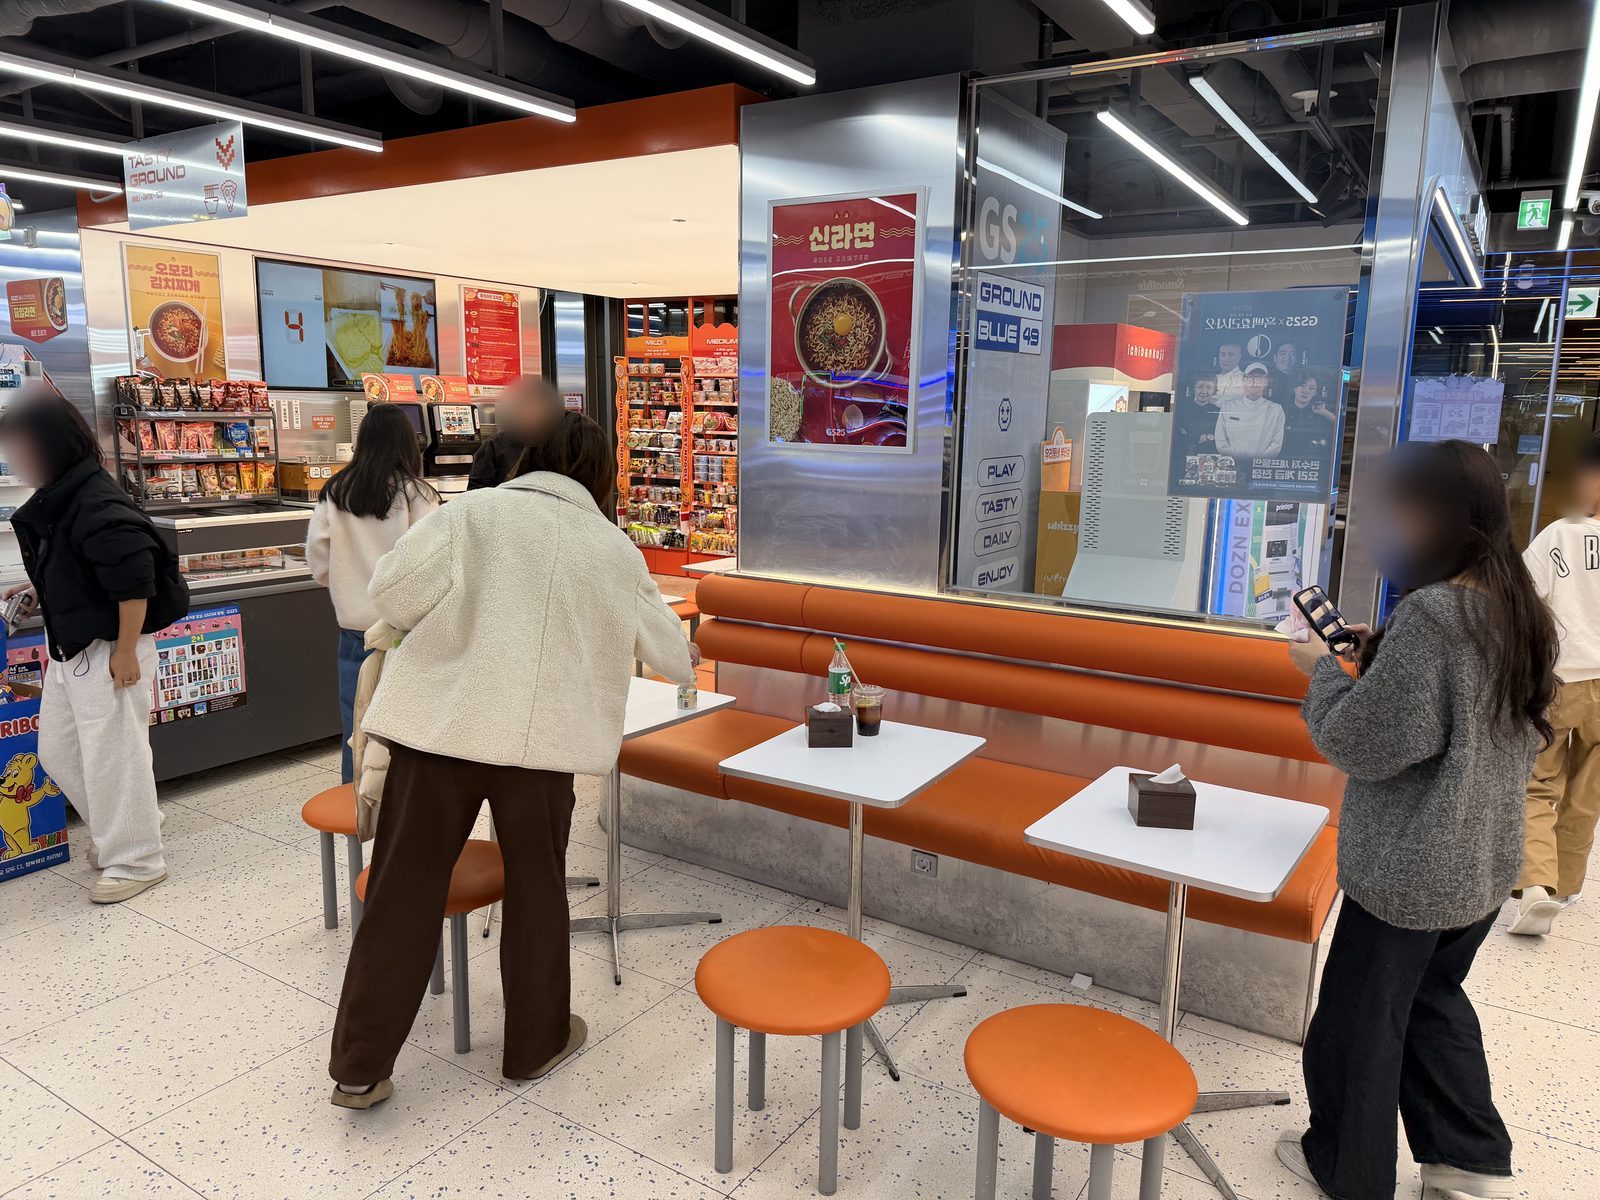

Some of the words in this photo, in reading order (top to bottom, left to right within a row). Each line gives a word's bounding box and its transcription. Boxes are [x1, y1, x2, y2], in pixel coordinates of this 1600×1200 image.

[128, 148, 172, 169] TASTY
[129, 164, 185, 187] GROUND
[809, 221, 875, 252] 신라면
[155, 263, 193, 277] 오모리
[150, 276, 200, 293] 김치찌개
[980, 282, 1041, 312] GROUND
[284, 310, 304, 342] 4
[978, 320, 1018, 344] BLUE
[1022, 327, 1039, 347] 49
[987, 463, 1016, 479] PLAY
[982, 496, 1018, 514] TASTY
[983, 530, 1012, 549] DAILY
[978, 564, 1014, 586] ENJOY
[1229, 536, 1248, 594] DOZN
